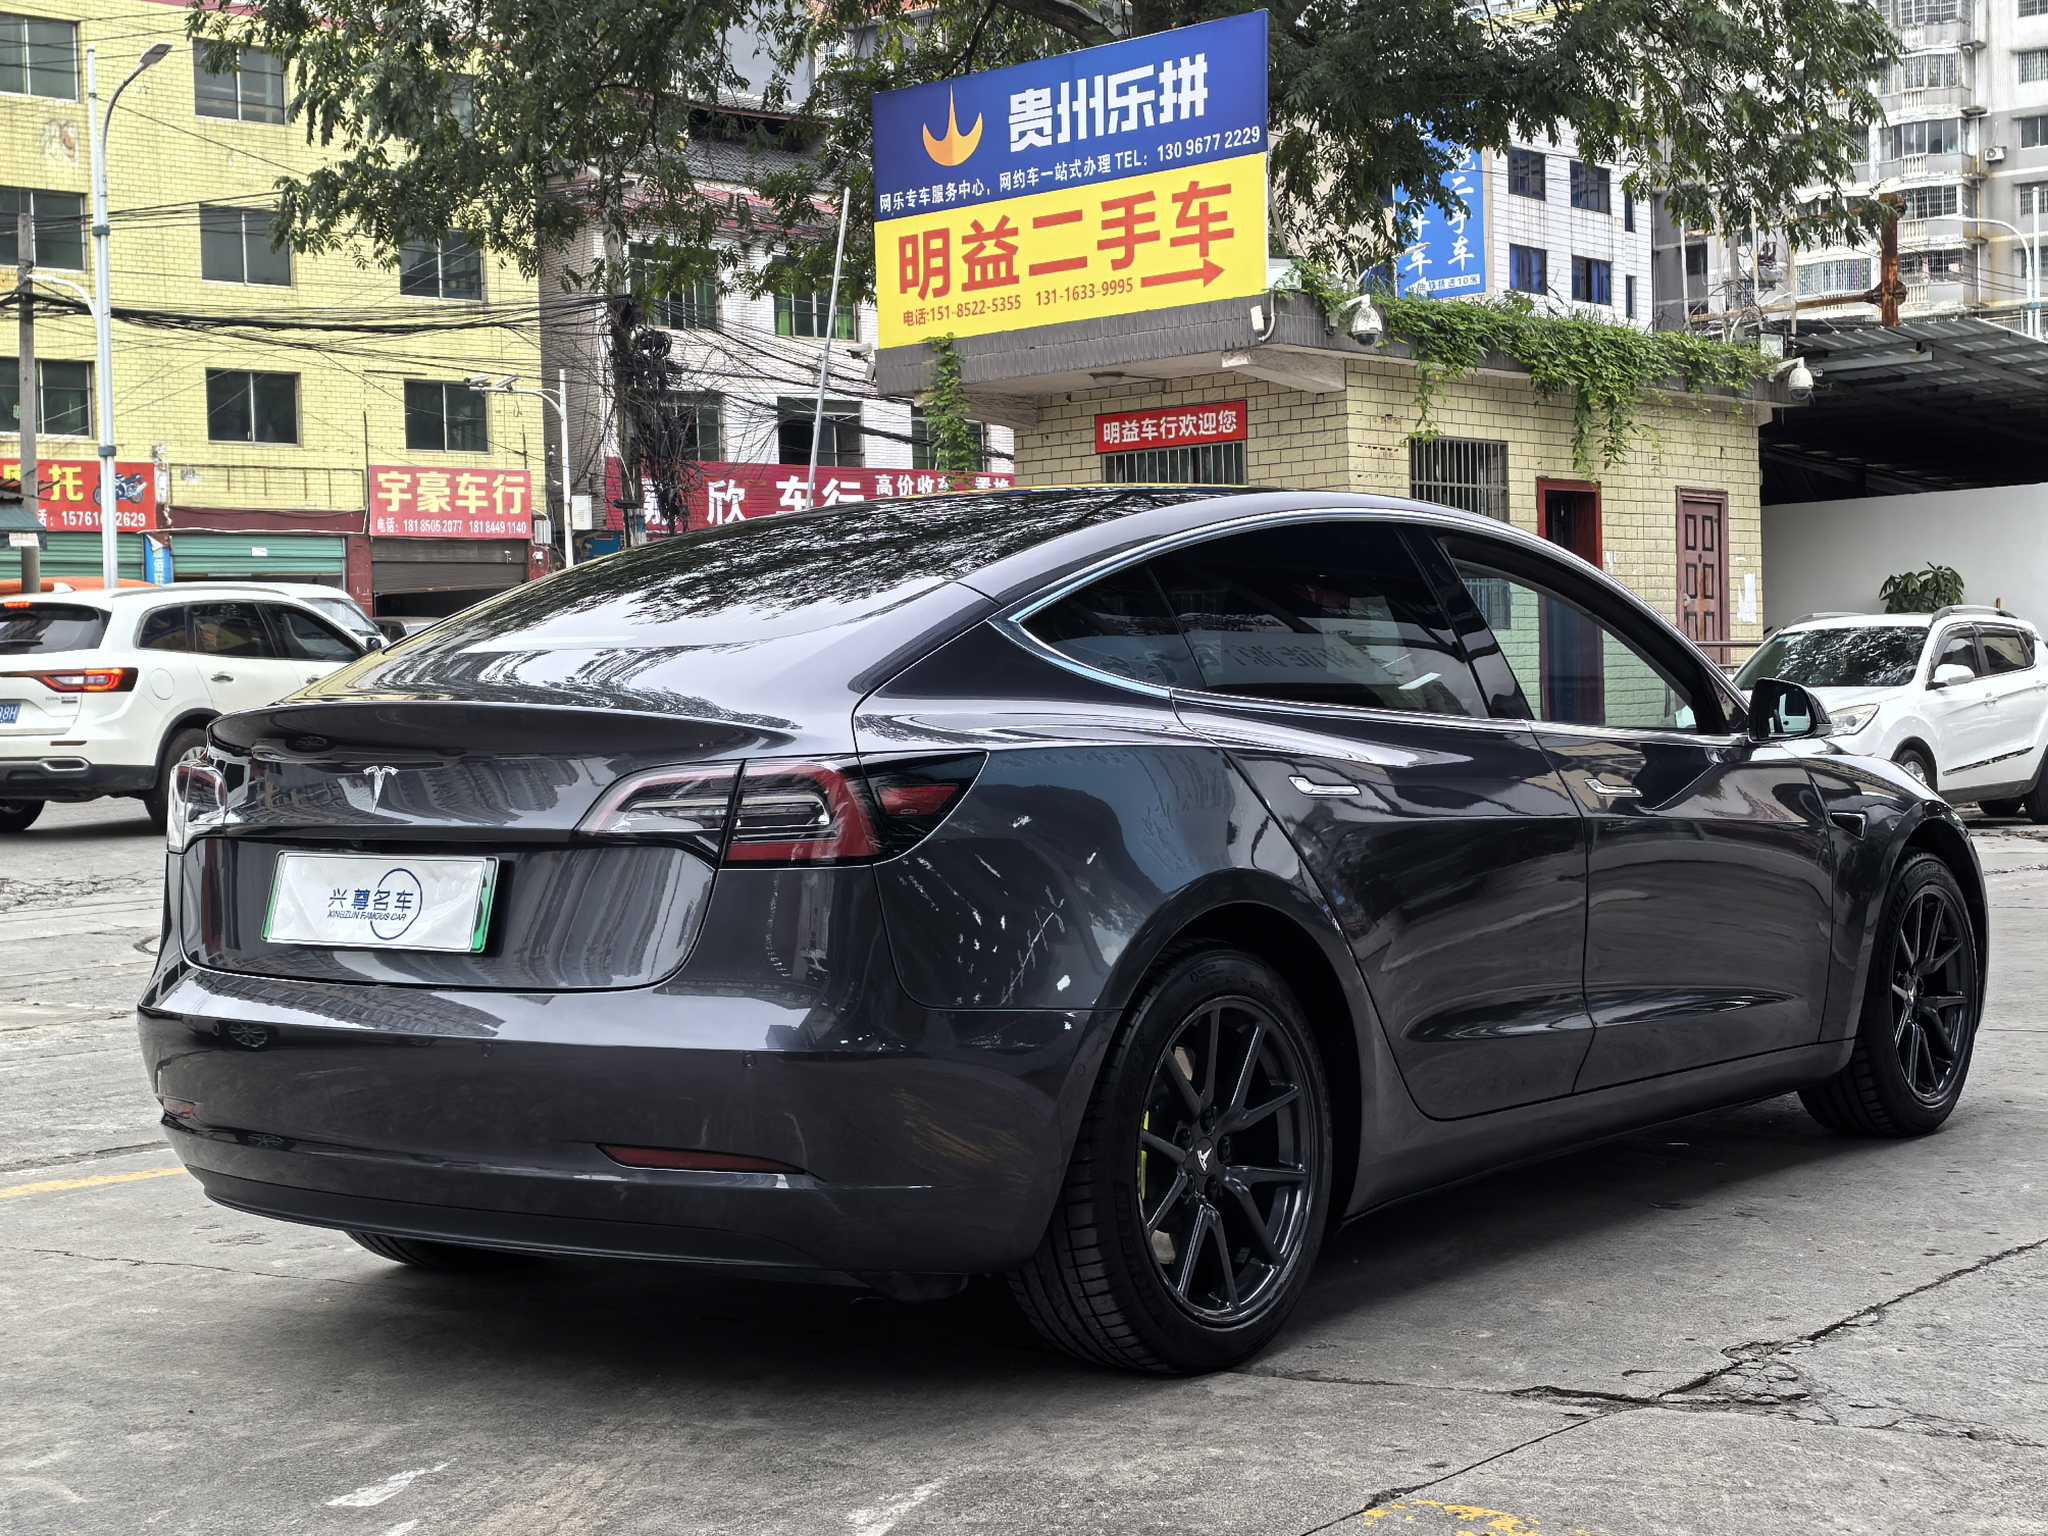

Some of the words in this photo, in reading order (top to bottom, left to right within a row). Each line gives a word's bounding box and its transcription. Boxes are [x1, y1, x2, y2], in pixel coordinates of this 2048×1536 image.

[1009, 53, 1208, 152] 贵州乐拼
[999, 153, 1111, 192] 网约车一站式办理
[1157, 143, 1181, 162] 130
[1186, 133, 1221, 156] 9677
[1225, 126, 1260, 148] 2229
[898, 180, 1235, 300] 明益二手车
[1035, 277, 1133, 306] 131-1633-9995
[1103, 409, 1237, 444] 明益车行欢迎您
[377, 471, 526, 514] 宇豪车行
[328, 888, 414, 912] 兴尊名车
[360, 911, 390, 920] FAMOUS
[390, 913, 407, 921] CAR
